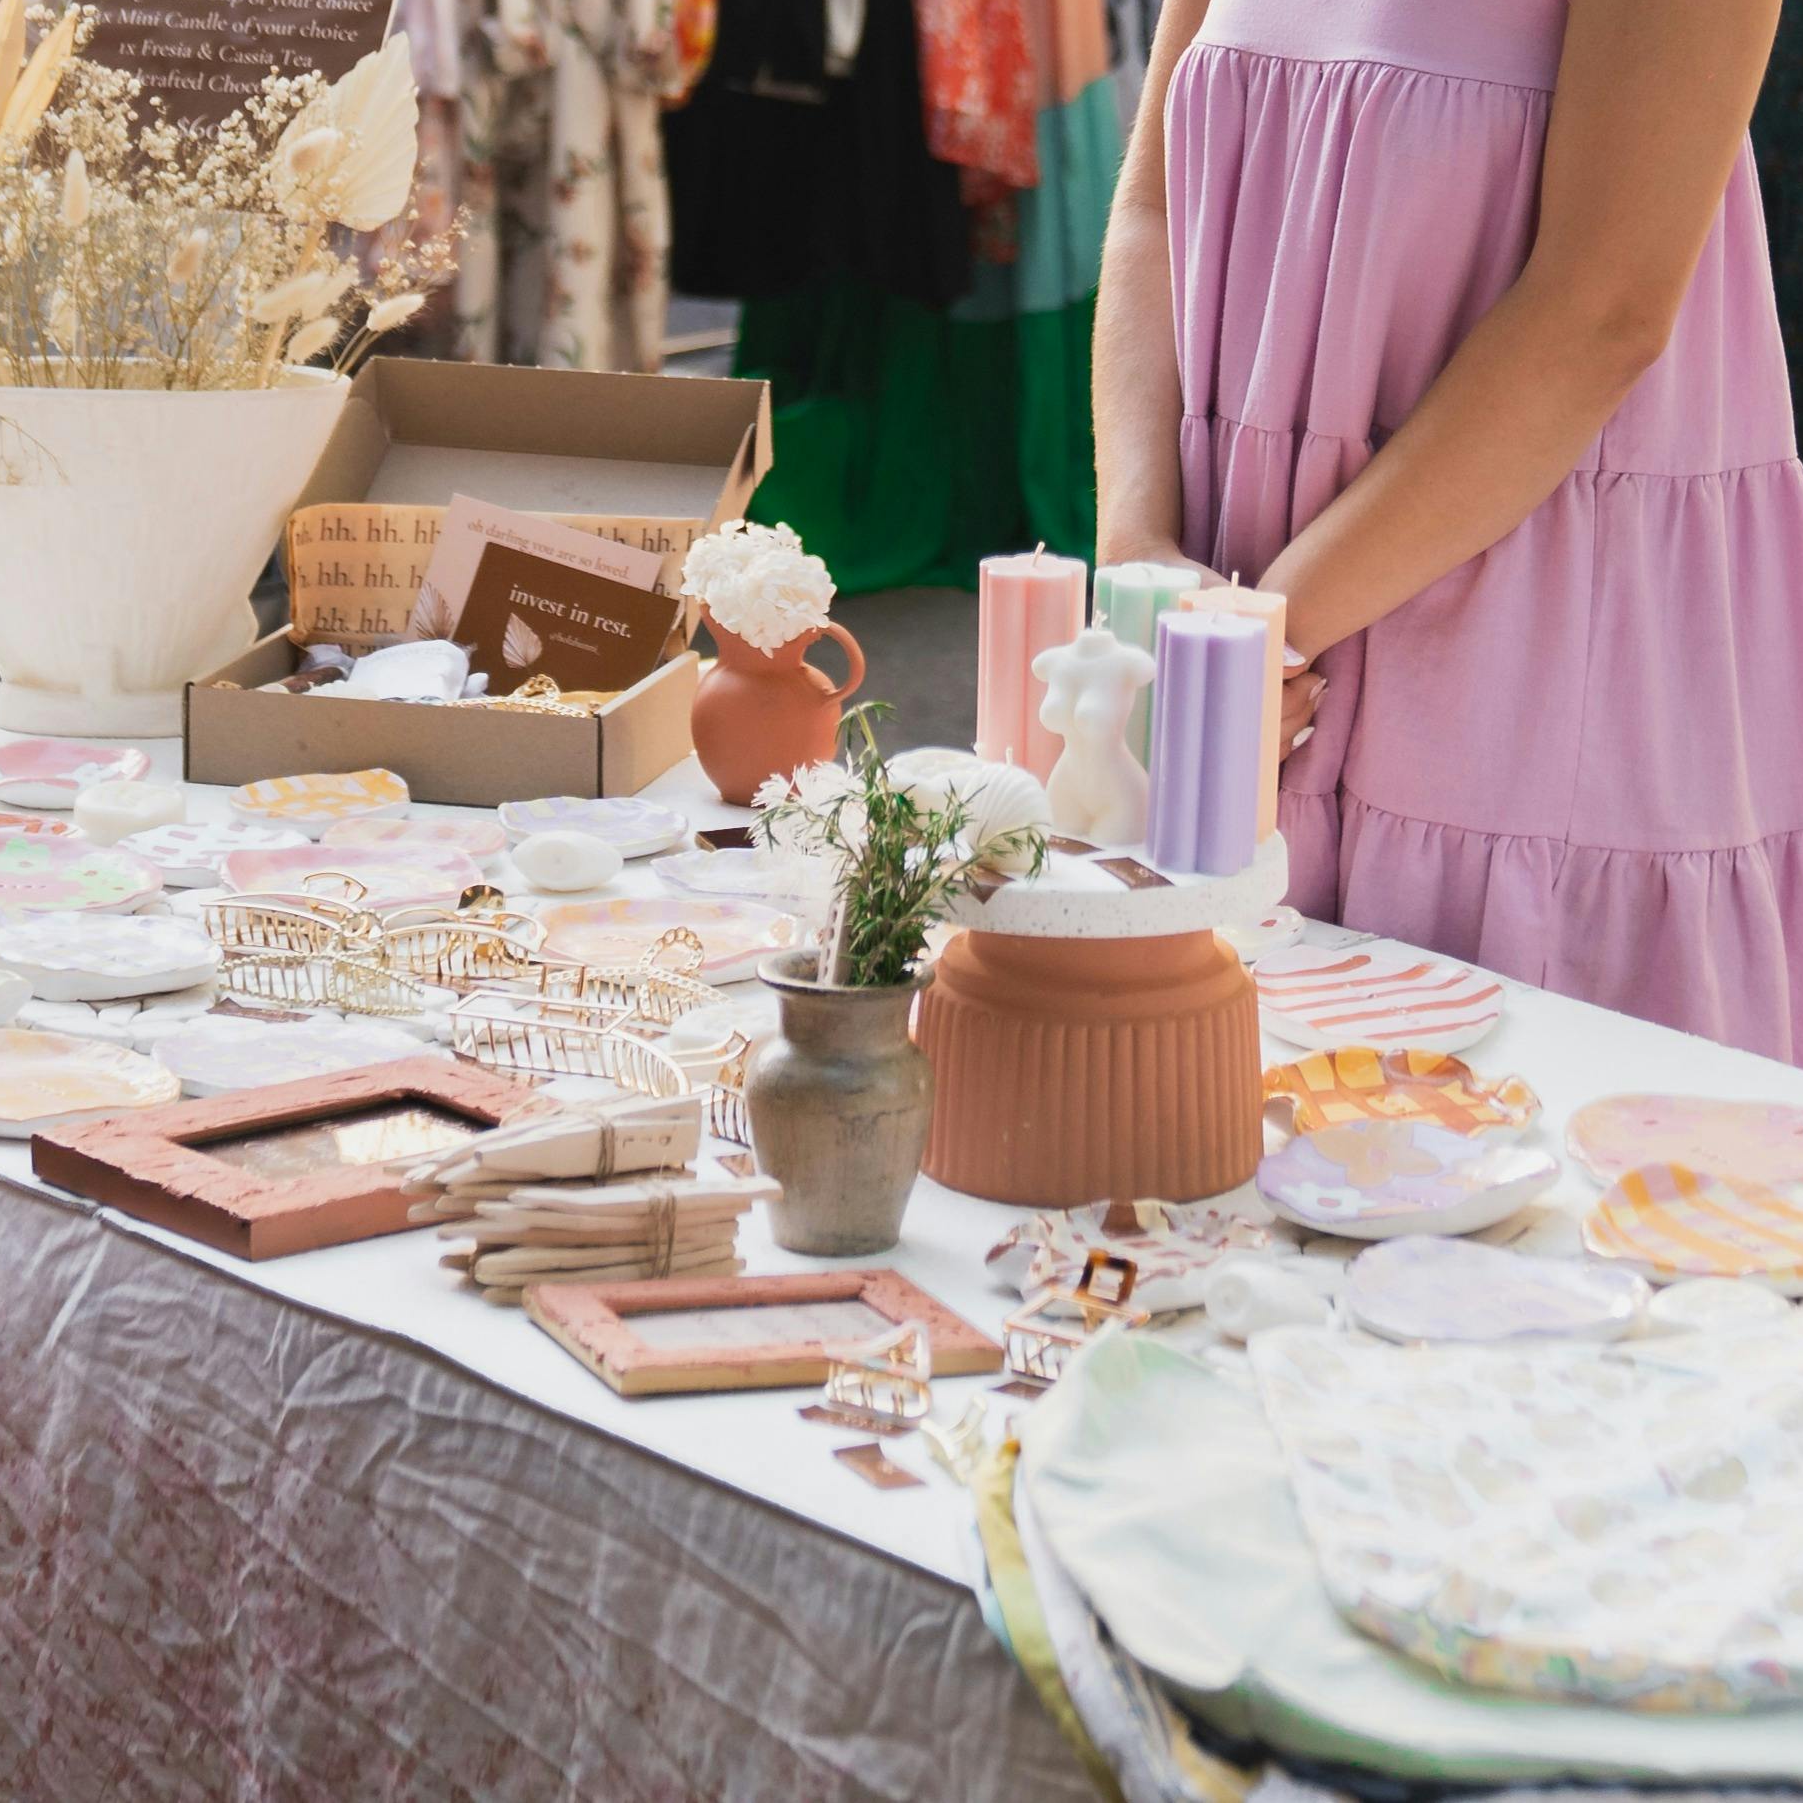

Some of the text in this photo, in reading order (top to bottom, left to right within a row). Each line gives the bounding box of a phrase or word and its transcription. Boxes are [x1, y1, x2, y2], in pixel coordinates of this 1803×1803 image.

[118, 7, 162, 27] Mini
[164, 11, 229, 32] Candle
[231, 15, 257, 35] of
[251, 23, 297, 40] your
[299, 19, 359, 43] choice
[141, 38, 192, 60] Fresia
[197, 41, 213, 61] &
[218, 44, 275, 66] Cassia
[281, 48, 314, 69] Tea
[467, 518, 484, 533] oh
[485, 524, 531, 551] darling
[532, 542, 555, 559] you
[556, 549, 576, 563] are
[578, 554, 593, 568] so
[508, 583, 633, 640] invest in rest.
